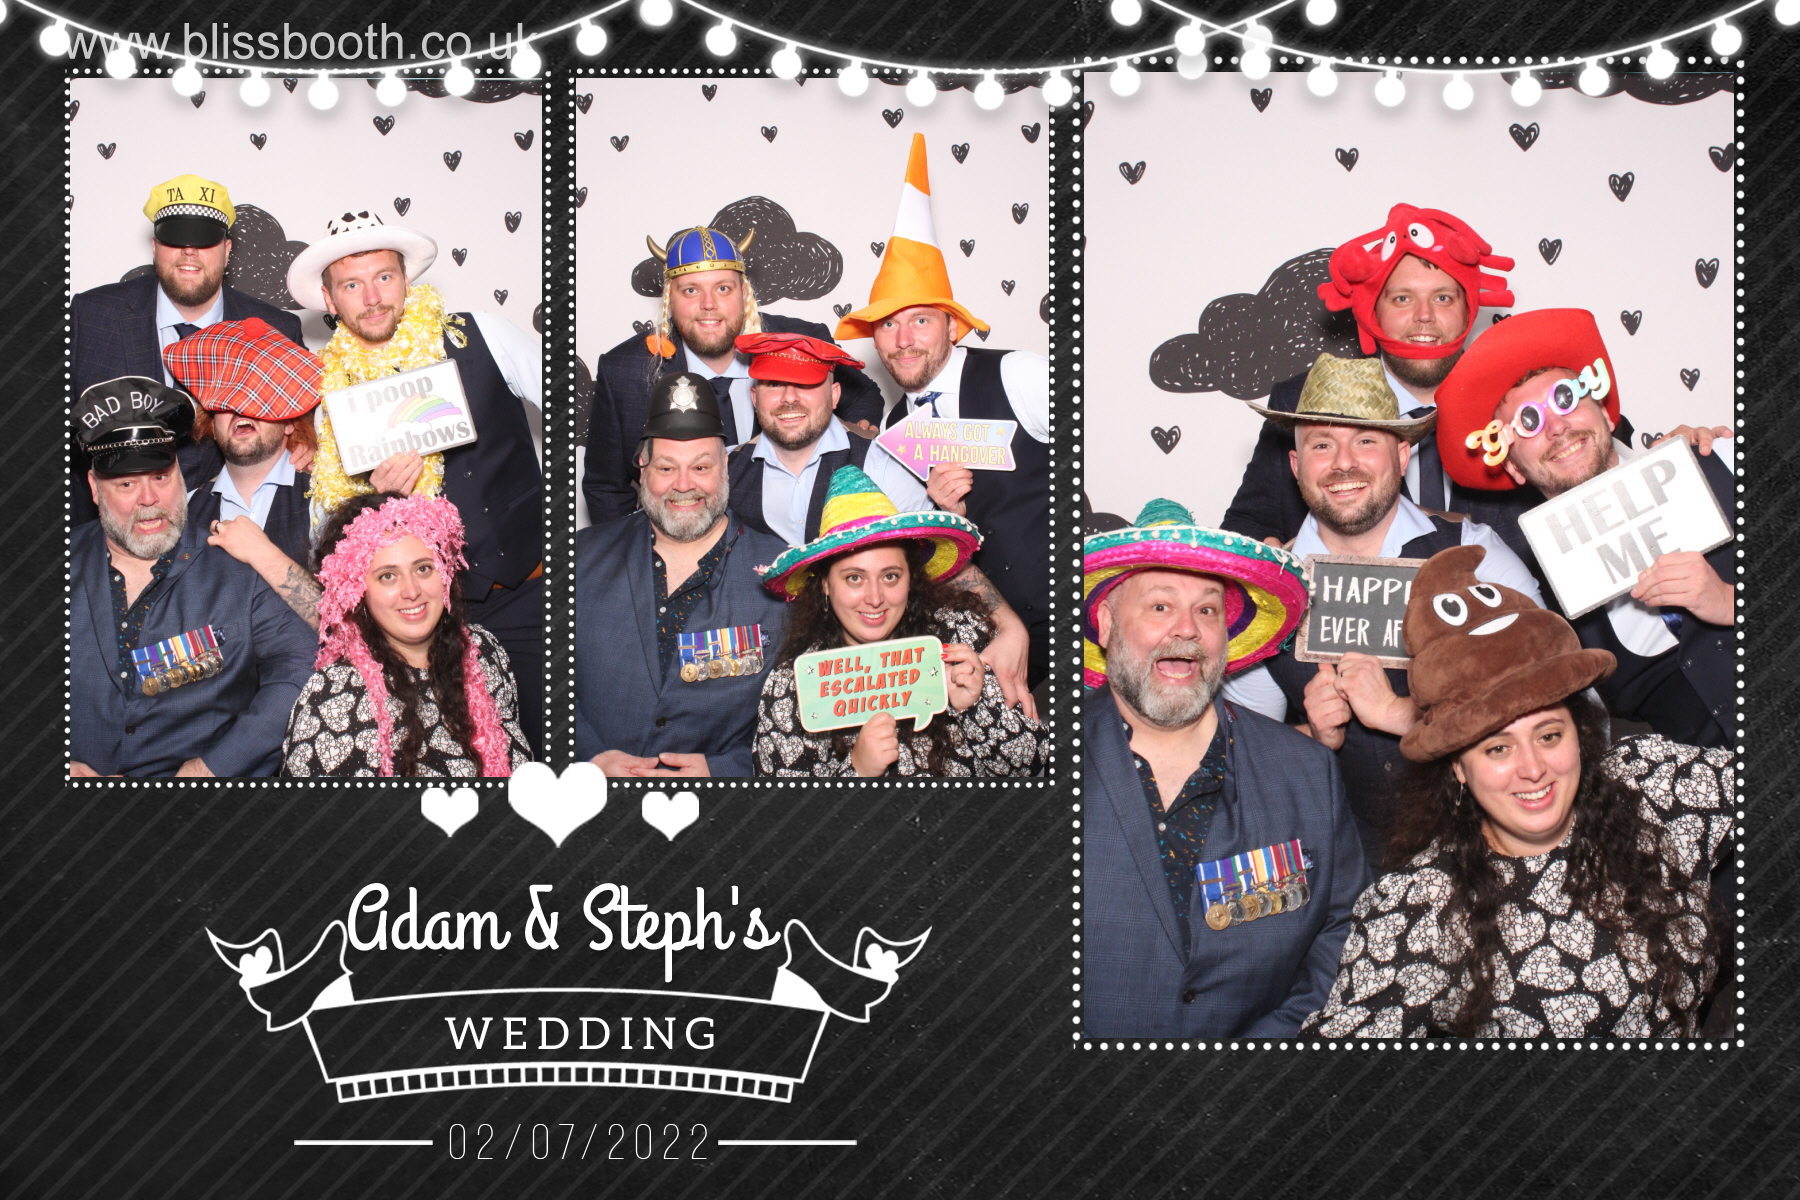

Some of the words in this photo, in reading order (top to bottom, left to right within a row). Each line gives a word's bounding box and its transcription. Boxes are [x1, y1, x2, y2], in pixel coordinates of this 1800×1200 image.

[81, 396, 121, 429] BAD
[130, 391, 165, 413] BOY
[365, 376, 434, 414] poop
[347, 421, 471, 468] Rainbows
[904, 421, 958, 440] ALWAYS
[963, 423, 991, 442] GOT
[913, 443, 924, 461] A
[929, 444, 1007, 466] HANGOVER
[1544, 459, 1677, 555] HELP
[1595, 515, 1682, 585] ME
[1320, 615, 1374, 649] EVER
[818, 655, 871, 678] WELL,
[879, 646, 925, 669] THAT
[819, 668, 920, 698] ESCALATED
[833, 690, 912, 717] QUICKLY
